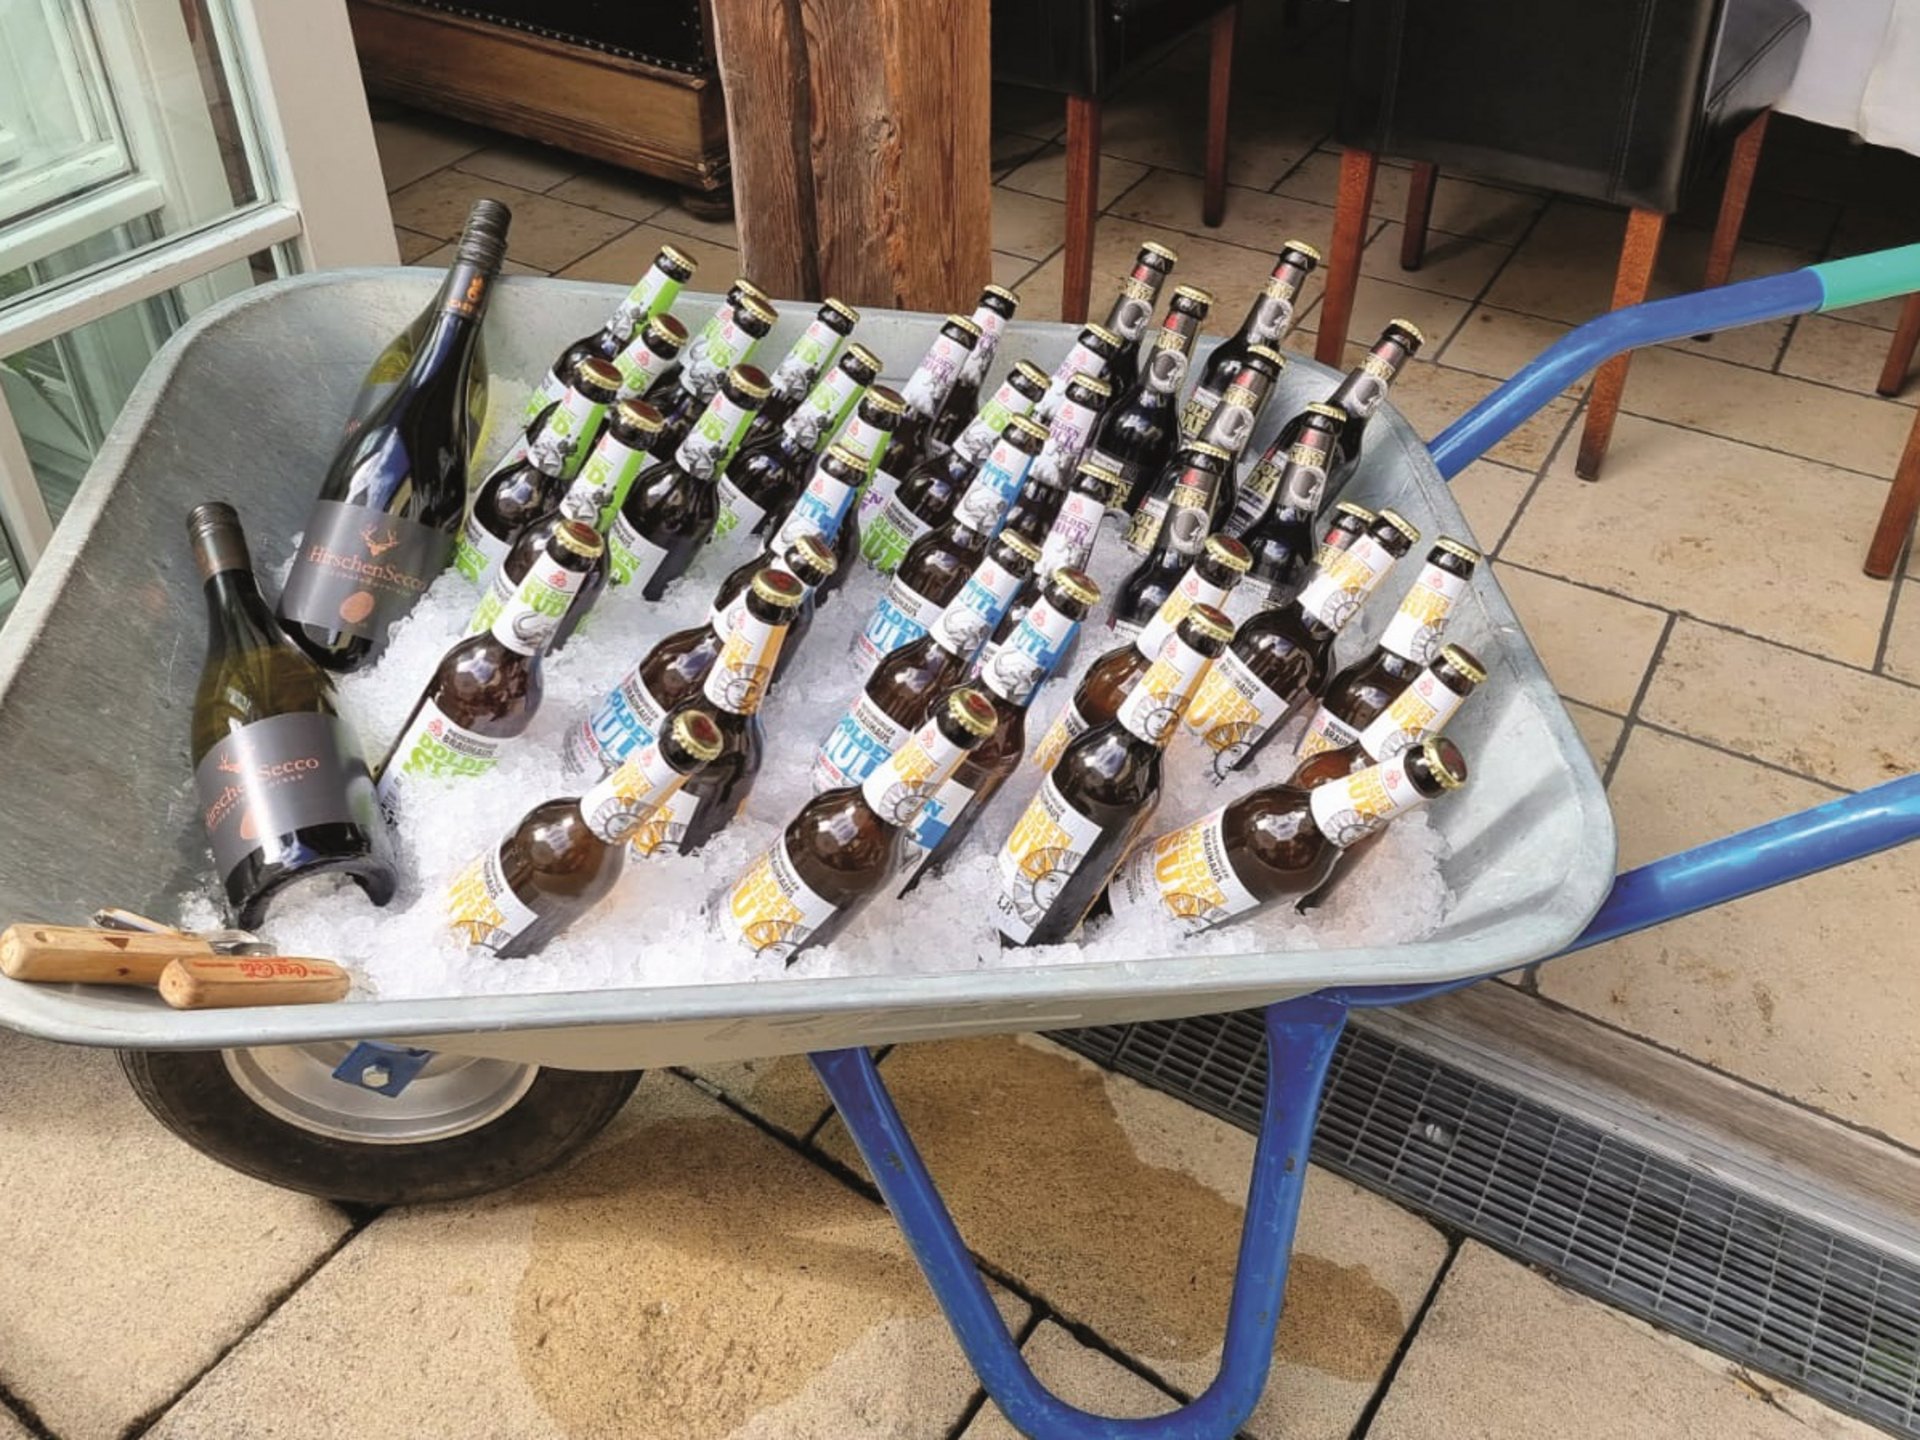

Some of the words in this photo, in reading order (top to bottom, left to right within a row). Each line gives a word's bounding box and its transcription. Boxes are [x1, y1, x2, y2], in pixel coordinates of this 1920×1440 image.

[309, 544, 425, 593] HirschenSecco
[518, 583, 566, 620] SUD
[1201, 828, 1224, 883] BRAUHAUS
